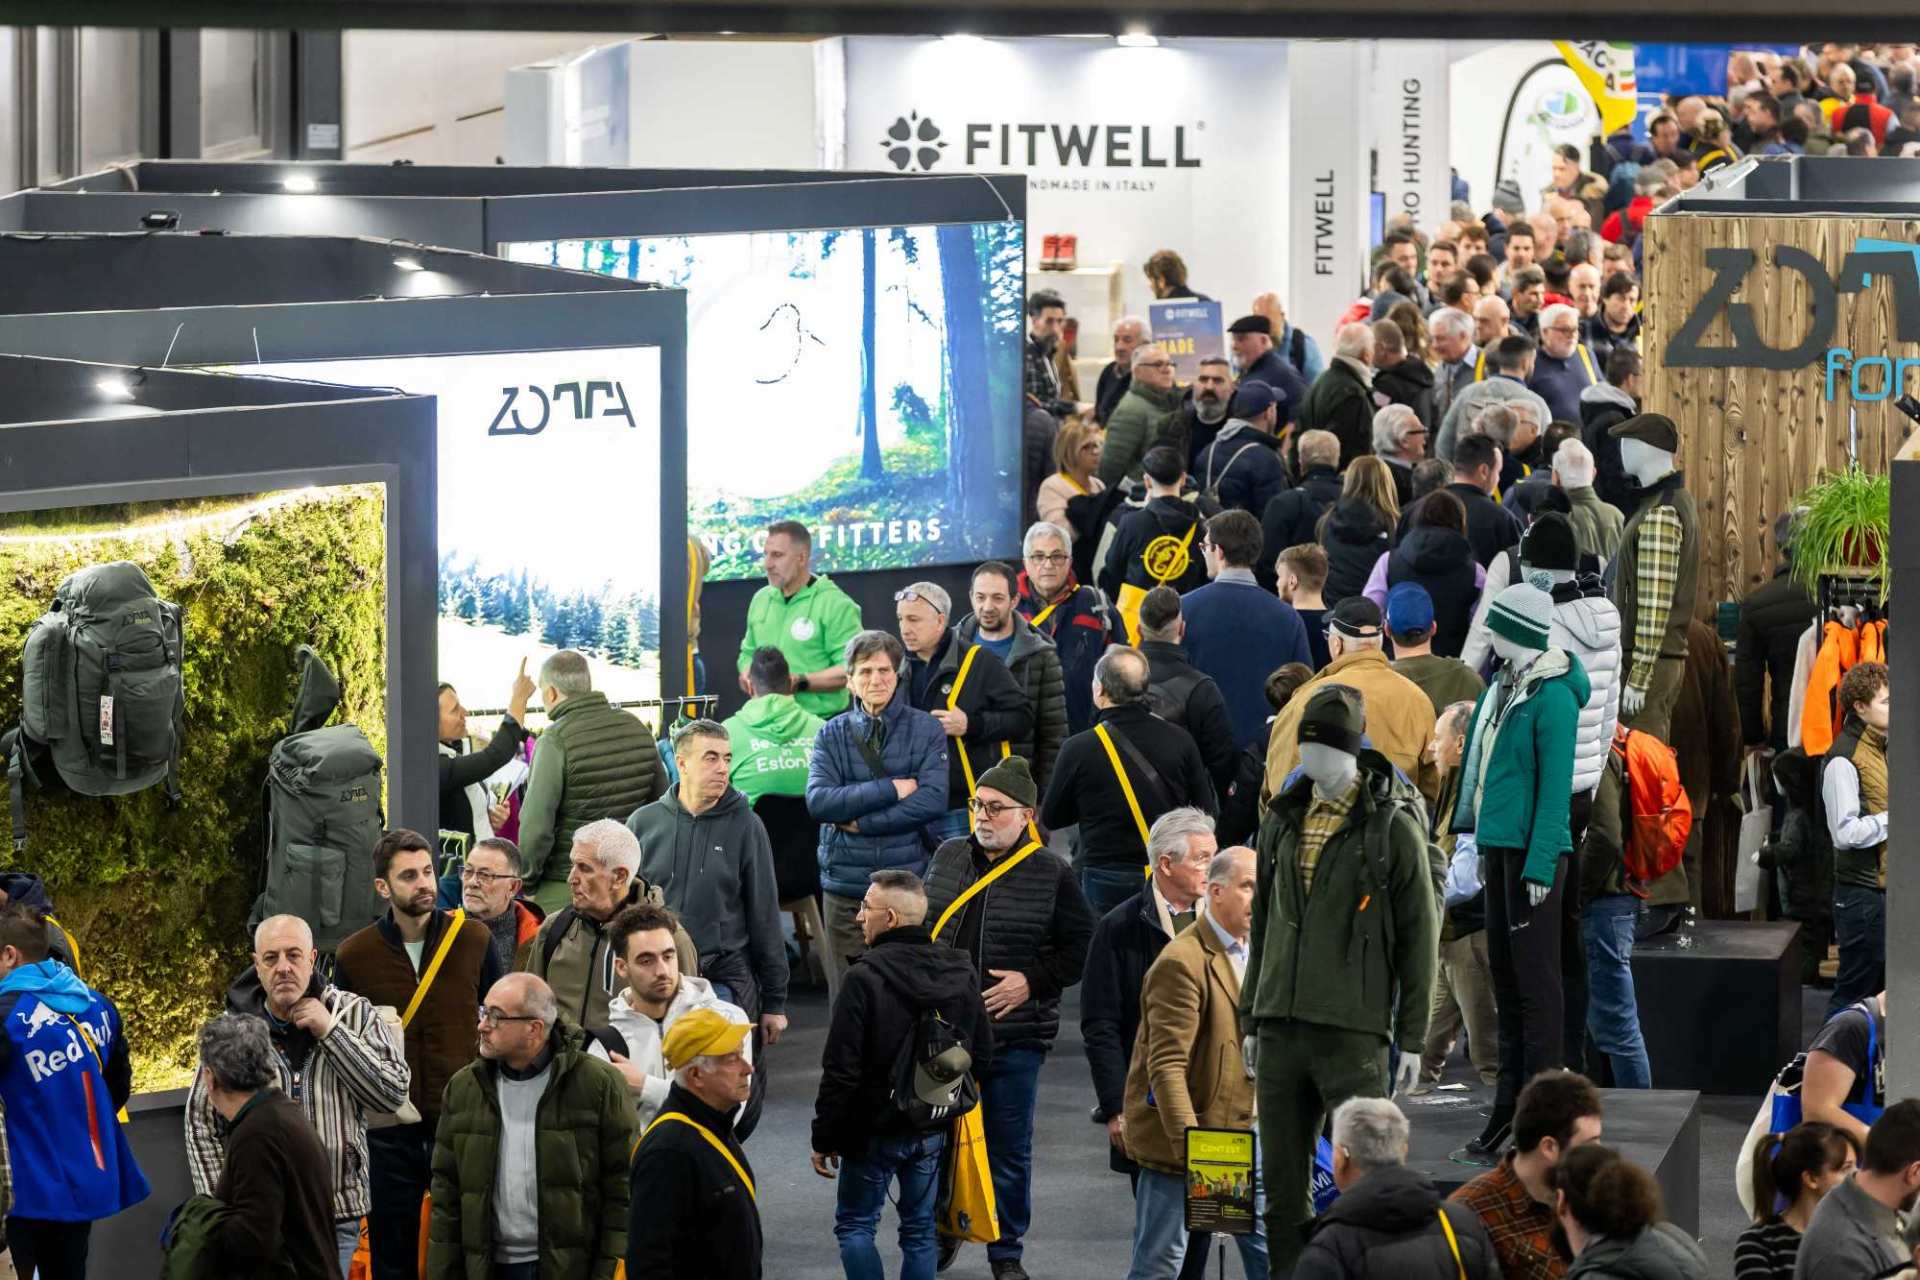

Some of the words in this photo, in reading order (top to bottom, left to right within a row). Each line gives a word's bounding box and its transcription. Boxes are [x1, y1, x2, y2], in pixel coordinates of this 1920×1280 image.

[966, 123, 1201, 168] FITWELL
[1402, 78, 1421, 183] HUNTING
[1096, 180, 1111, 191] IN
[1117, 180, 1156, 192] ITALY
[1314, 169, 1335, 276] FITWELL
[25, 1028, 84, 1083] Red
